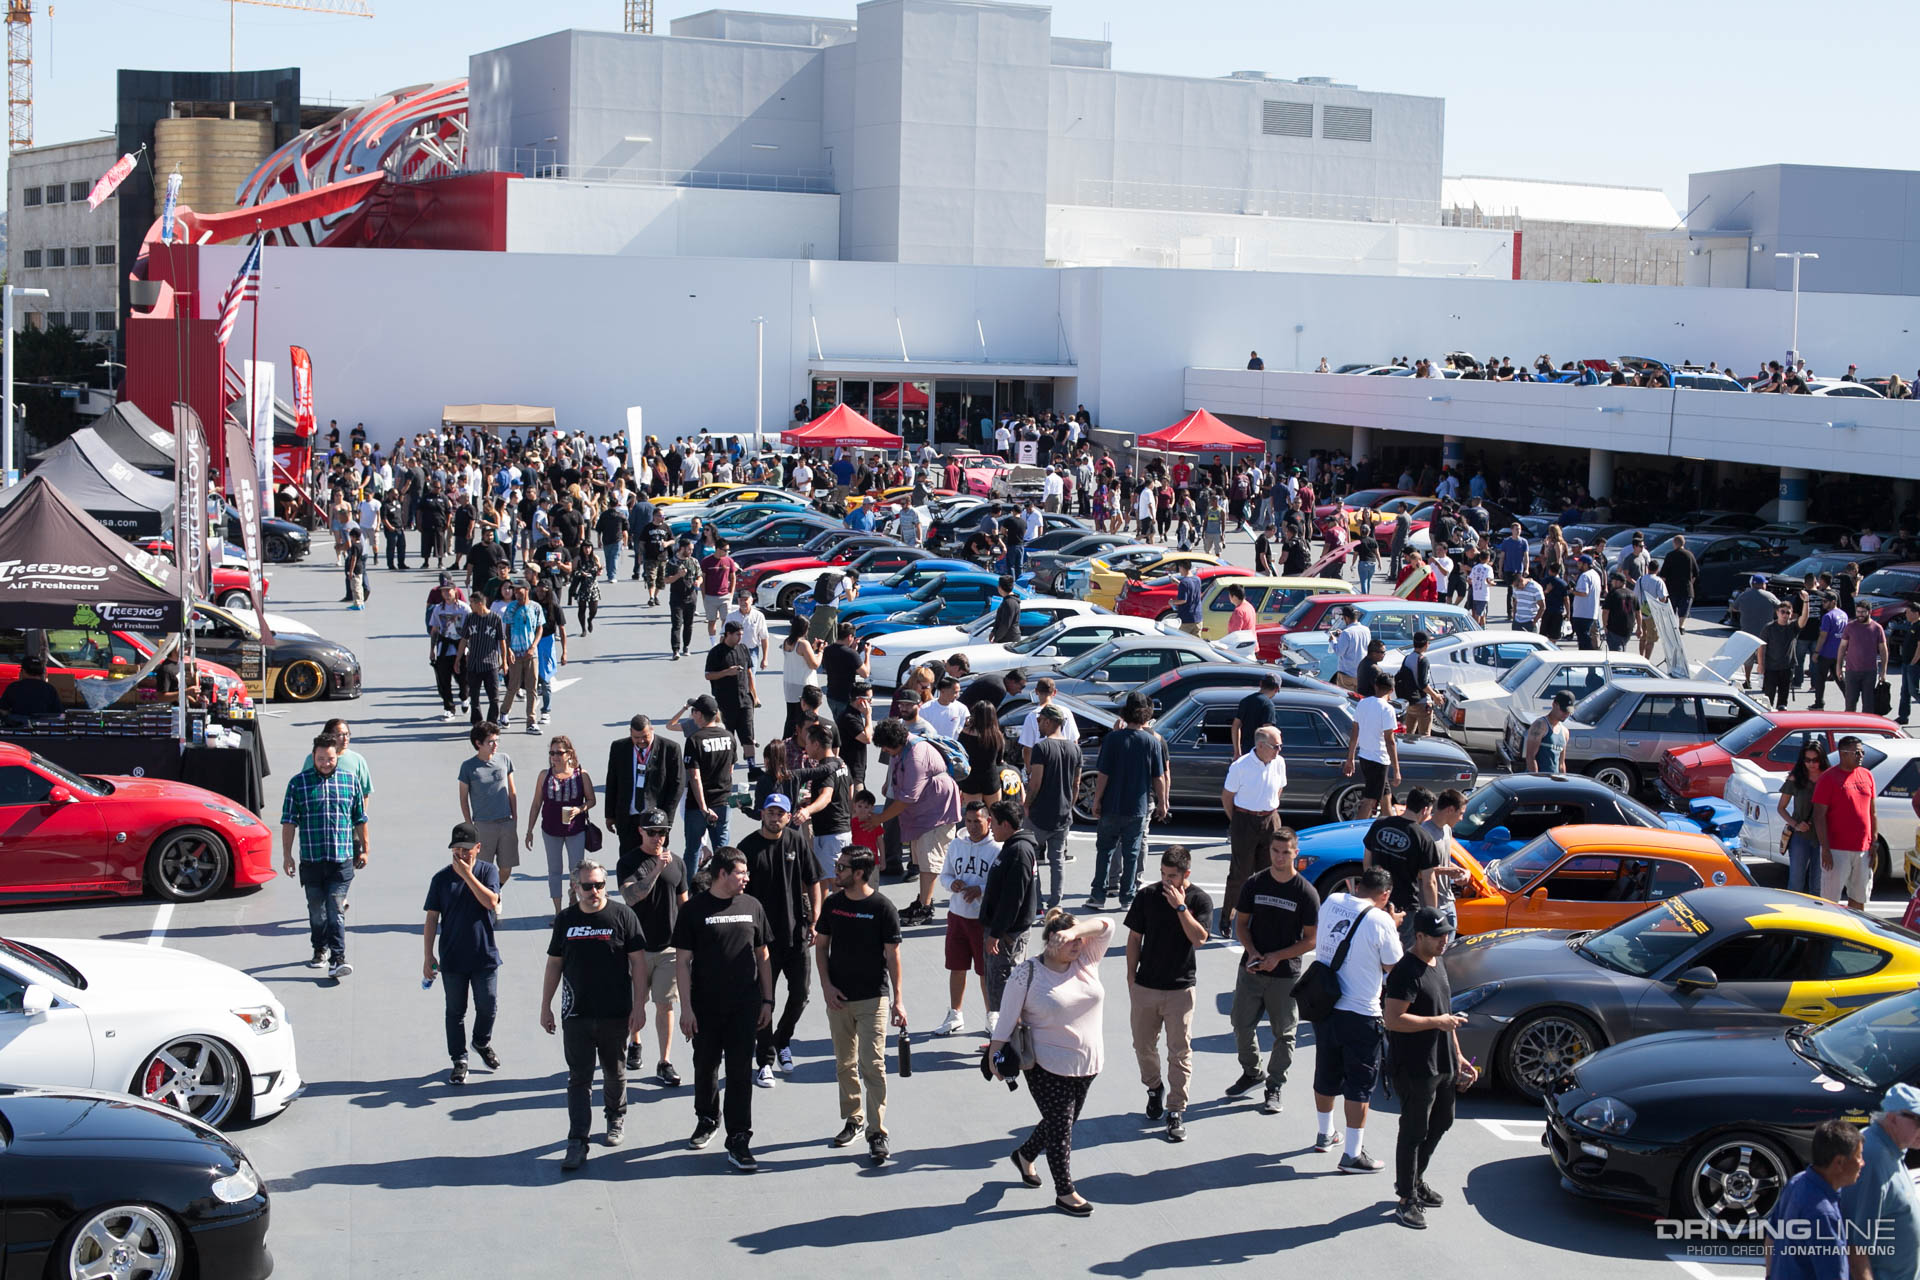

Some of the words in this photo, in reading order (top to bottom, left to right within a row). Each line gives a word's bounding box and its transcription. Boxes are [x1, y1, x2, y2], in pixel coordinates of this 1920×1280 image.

[7, 582, 29, 590] Air
[32, 582, 100, 591] Fresheners
[124, 622, 160, 630] Fresheners
[702, 736, 732, 753] STAFF
[1382, 830, 1408, 848] HPS
[954, 856, 989, 878] GAP
